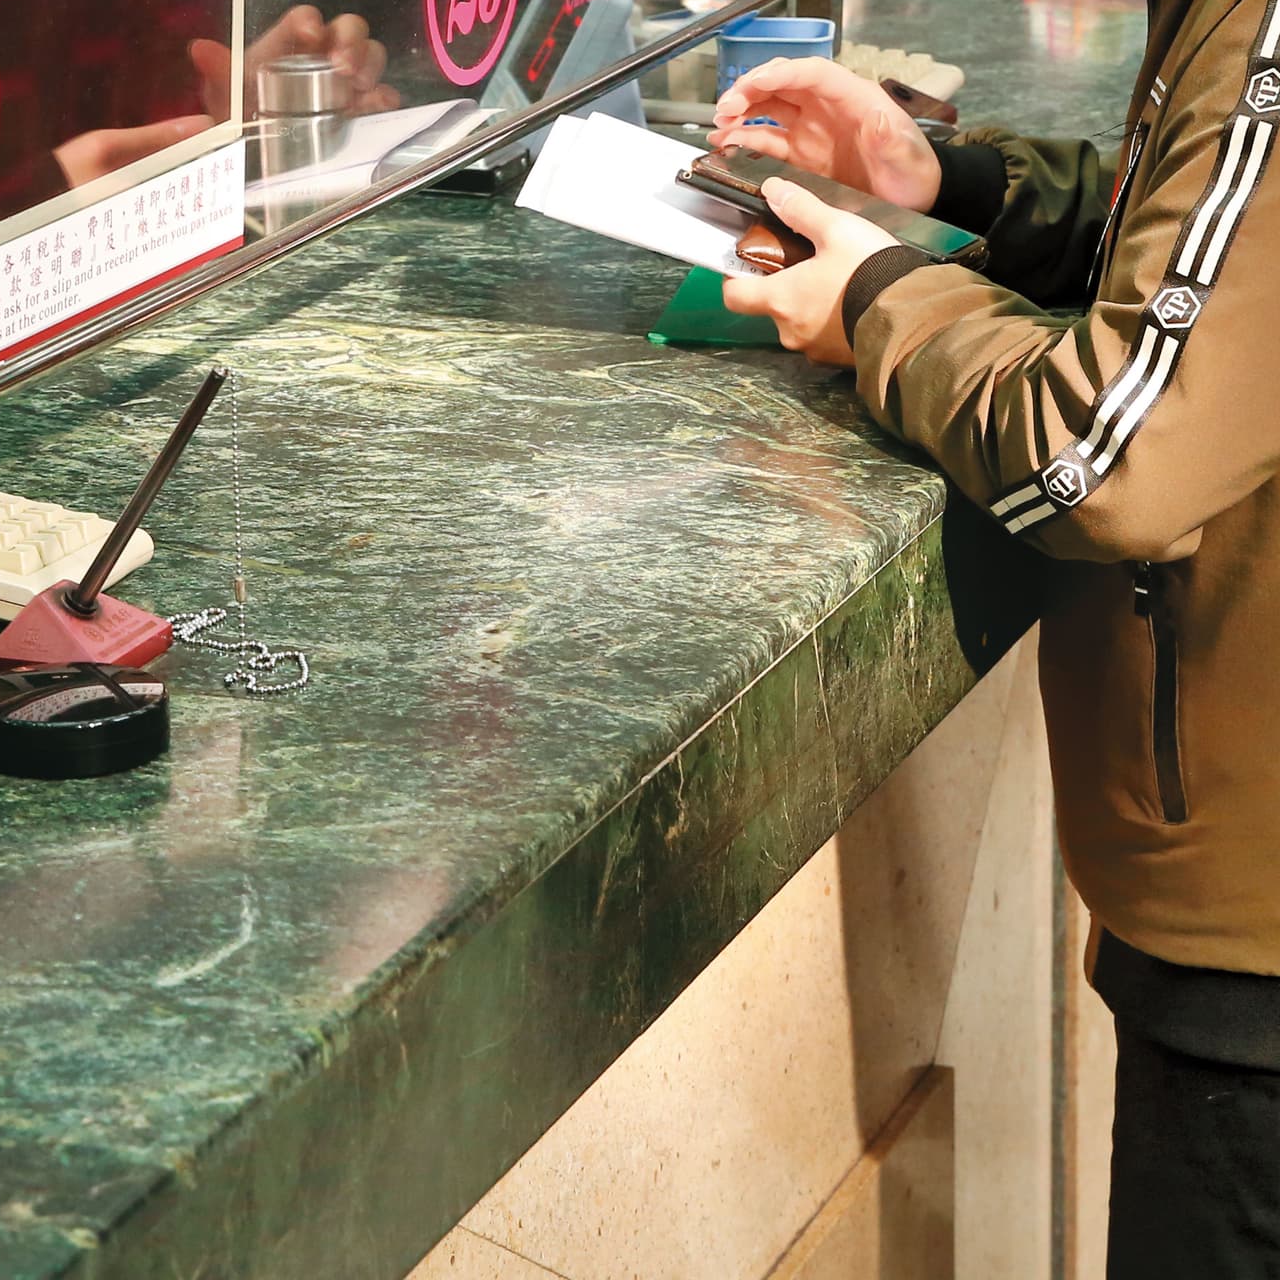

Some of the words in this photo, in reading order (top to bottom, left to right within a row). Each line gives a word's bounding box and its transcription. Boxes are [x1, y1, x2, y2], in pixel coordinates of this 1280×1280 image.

[3, 300, 22, 319] ask
[25, 293, 41, 309] for
[52, 278, 71, 296] slip
[74, 266, 93, 286] and
[104, 246, 138, 272] receipt
[141, 234, 168, 253] when
[170, 225, 188, 243] you
[190, 216, 206, 235] pay
[209, 206, 233, 223] taxes
[5, 324, 16, 338] at
[18, 313, 36, 330] the
[38, 293, 81, 321] counter.
